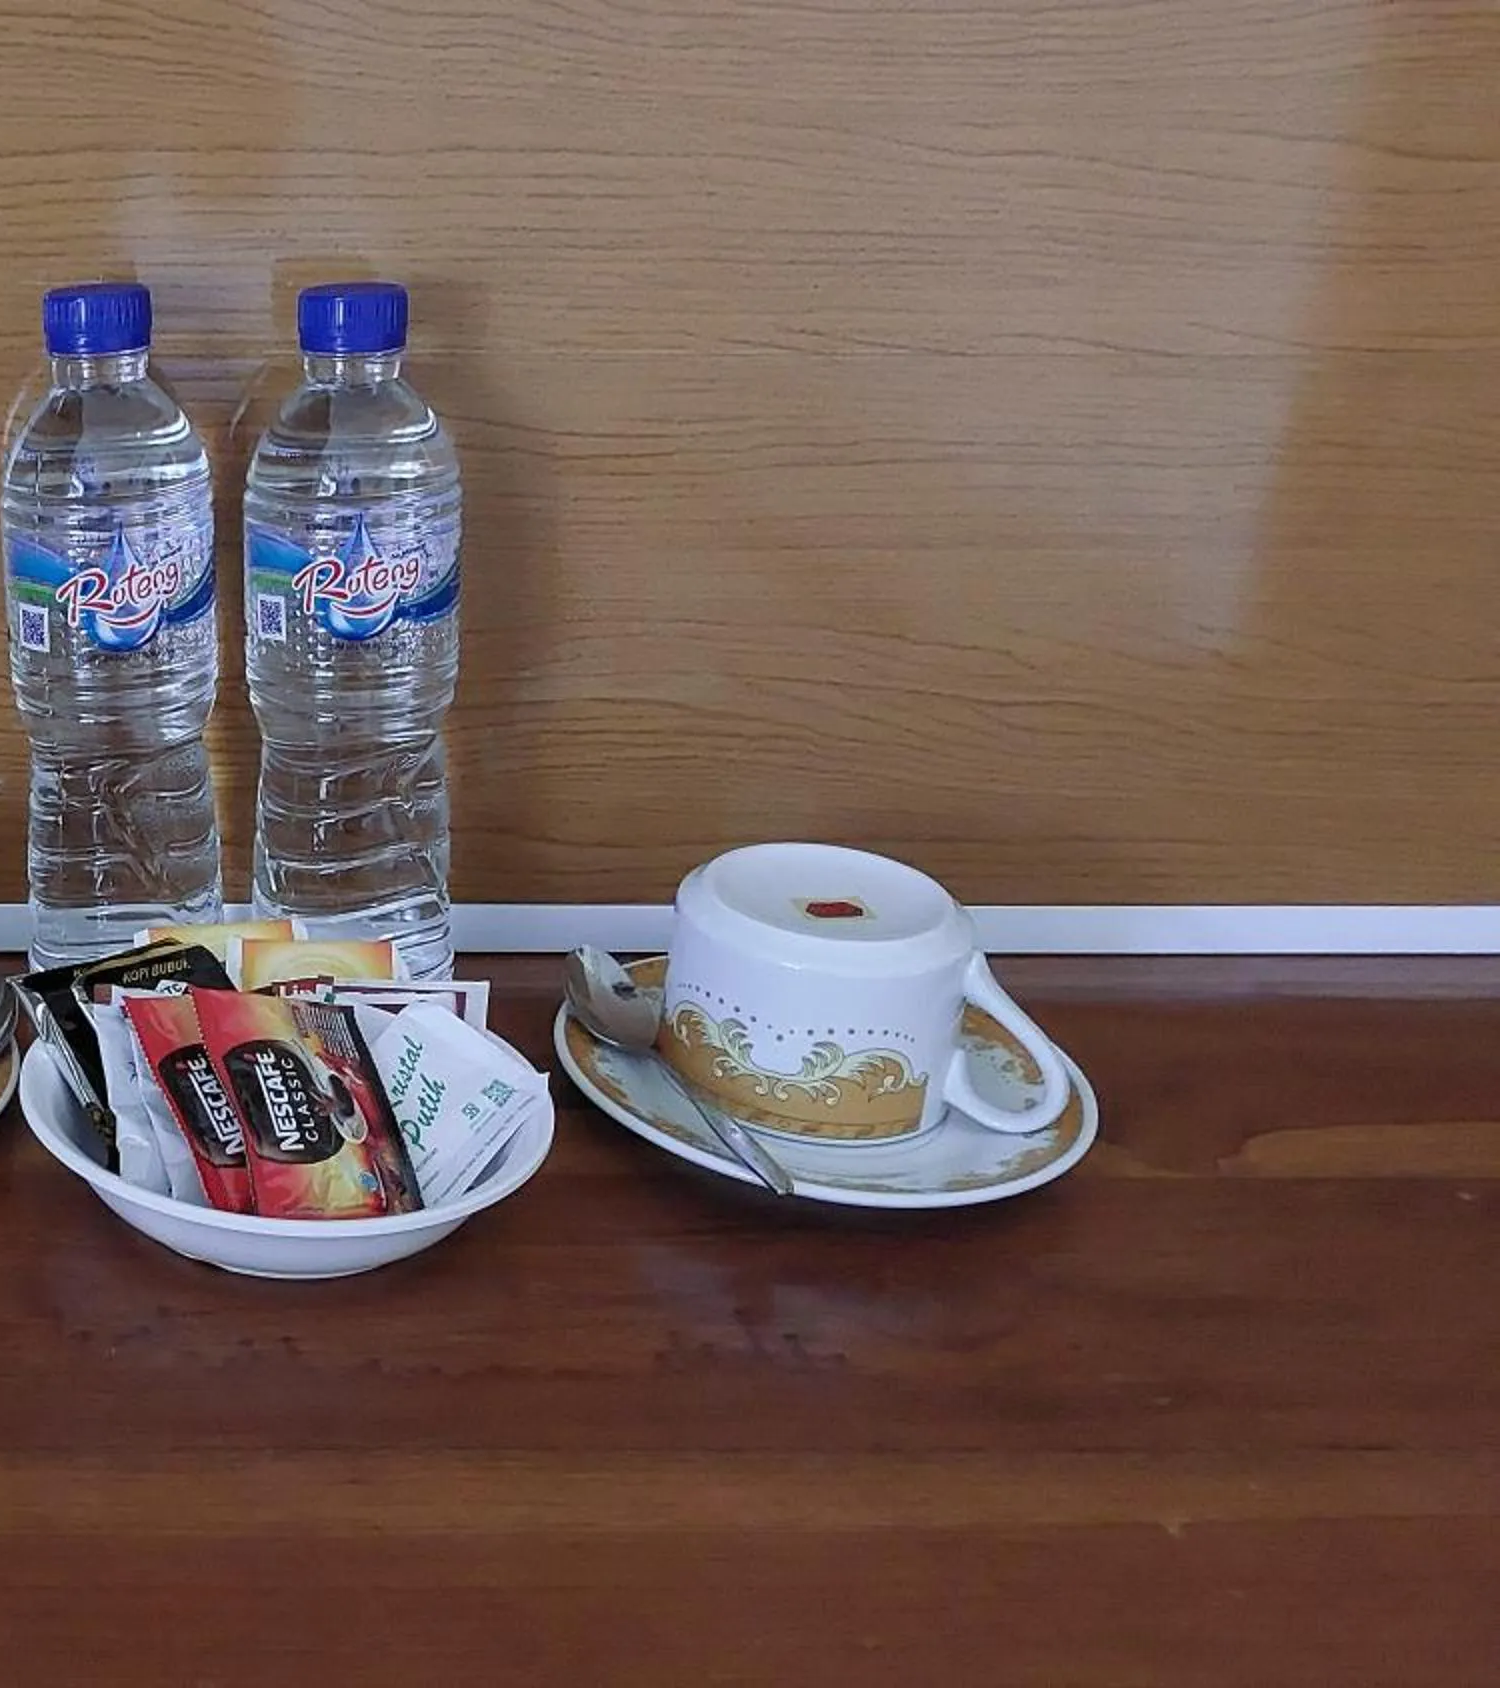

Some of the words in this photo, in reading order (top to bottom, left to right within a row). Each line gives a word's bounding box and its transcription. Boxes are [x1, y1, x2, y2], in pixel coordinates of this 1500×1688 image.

[57, 562, 180, 627] Ruteng
[293, 554, 420, 615] Ruteng
[281, 1057, 319, 1142] CLASSIC
[400, 1073, 446, 1151] Putih
